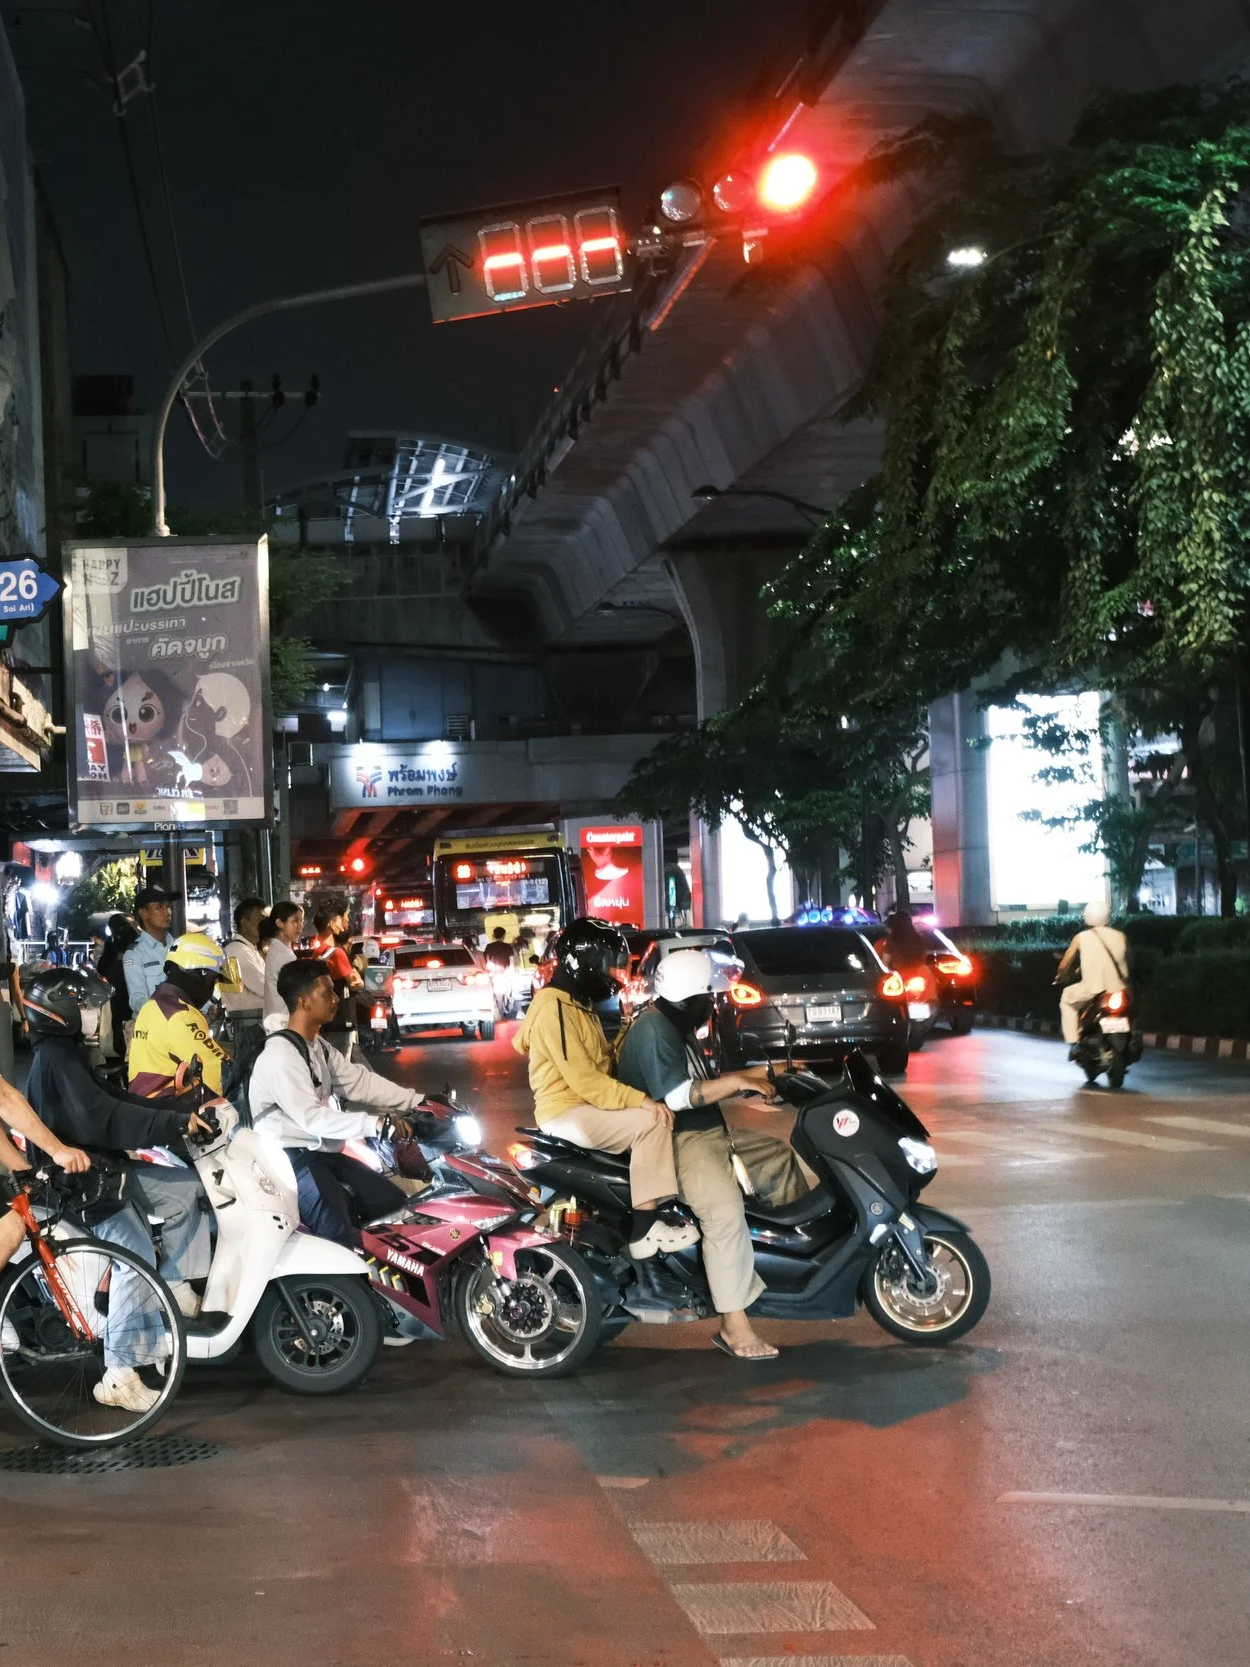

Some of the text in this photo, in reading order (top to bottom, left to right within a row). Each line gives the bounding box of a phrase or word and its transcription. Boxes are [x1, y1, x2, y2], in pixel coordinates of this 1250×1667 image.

[131, 571, 238, 610] แฮปปี้โนส
[3, 604, 16, 613] Soi
[150, 634, 227, 659] คัดจมูก
[388, 762, 458, 782] พร้อมพงษ์
[387, 786, 463, 799] Phrom Phong
[154, 822, 176, 831] Plan
[386, 1248, 425, 1277] YAMAHA
